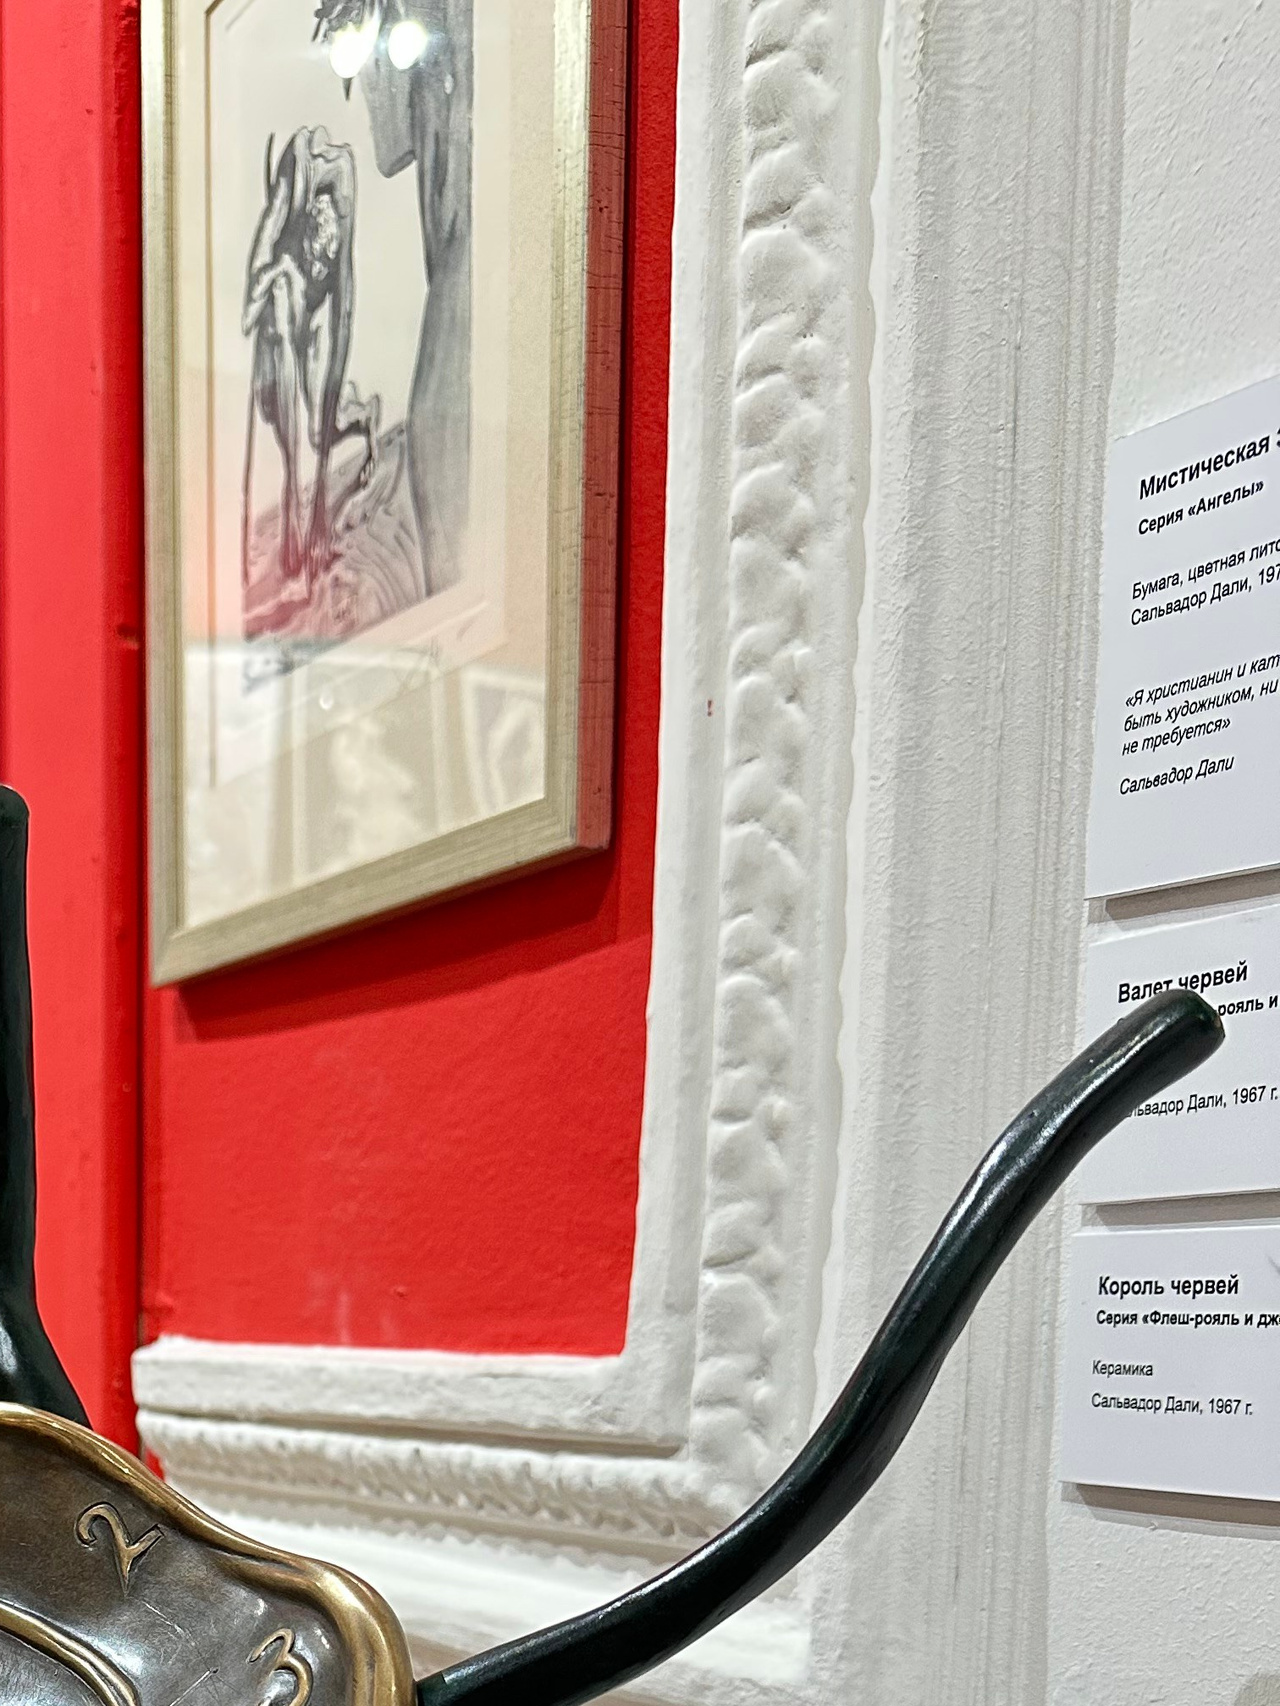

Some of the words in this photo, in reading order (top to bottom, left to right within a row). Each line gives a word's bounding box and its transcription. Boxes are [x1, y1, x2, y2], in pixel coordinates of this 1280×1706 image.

[1138, 435, 1271, 500] Мистическая
[1138, 508, 1184, 535] Серия
[1188, 481, 1264, 517] «Ангелы»
[1132, 573, 1183, 600] Бумага,
[1188, 551, 1245, 583] цветная
[1131, 591, 1207, 626] Сальвадор
[1210, 577, 1252, 604] Дали,
[1125, 689, 1144, 707] «Я
[1146, 667, 1233, 705] христианин
[1236, 663, 1247, 678] и
[1124, 712, 1162, 732] быть
[1165, 686, 1254, 723] художником,
[1260, 679, 1279, 696] ни
[1122, 740, 1138, 756] не
[1142, 718, 1231, 753] требуется»
[1120, 767, 1193, 795] Сальвадор
[1195, 757, 1235, 780] Дали
[1118, 979, 1173, 1003] Валет
[1178, 960, 1248, 993] червей
[1269, 994, 1278, 1009] и
[1187, 1093, 1226, 1114] Дали,
[1232, 1085, 1266, 1106] 1967
[1270, 1086, 1279, 1101] г.
[1098, 1275, 1165, 1300] Король
[1171, 1274, 1239, 1299] червей
[1096, 1310, 1138, 1328] Серия
[1142, 1310, 1240, 1329] «Флеш-рояль
[1244, 1313, 1253, 1326] и
[1257, 1313, 1280, 1329] дж
[1092, 1360, 1153, 1378] Керамика
[1091, 1393, 1162, 1414] Сальвадор
[1164, 1396, 1203, 1415] Дали,
[1208, 1397, 1241, 1415] 1967
[1245, 1402, 1253, 1415] г.
[74, 1501, 165, 1597] 2
